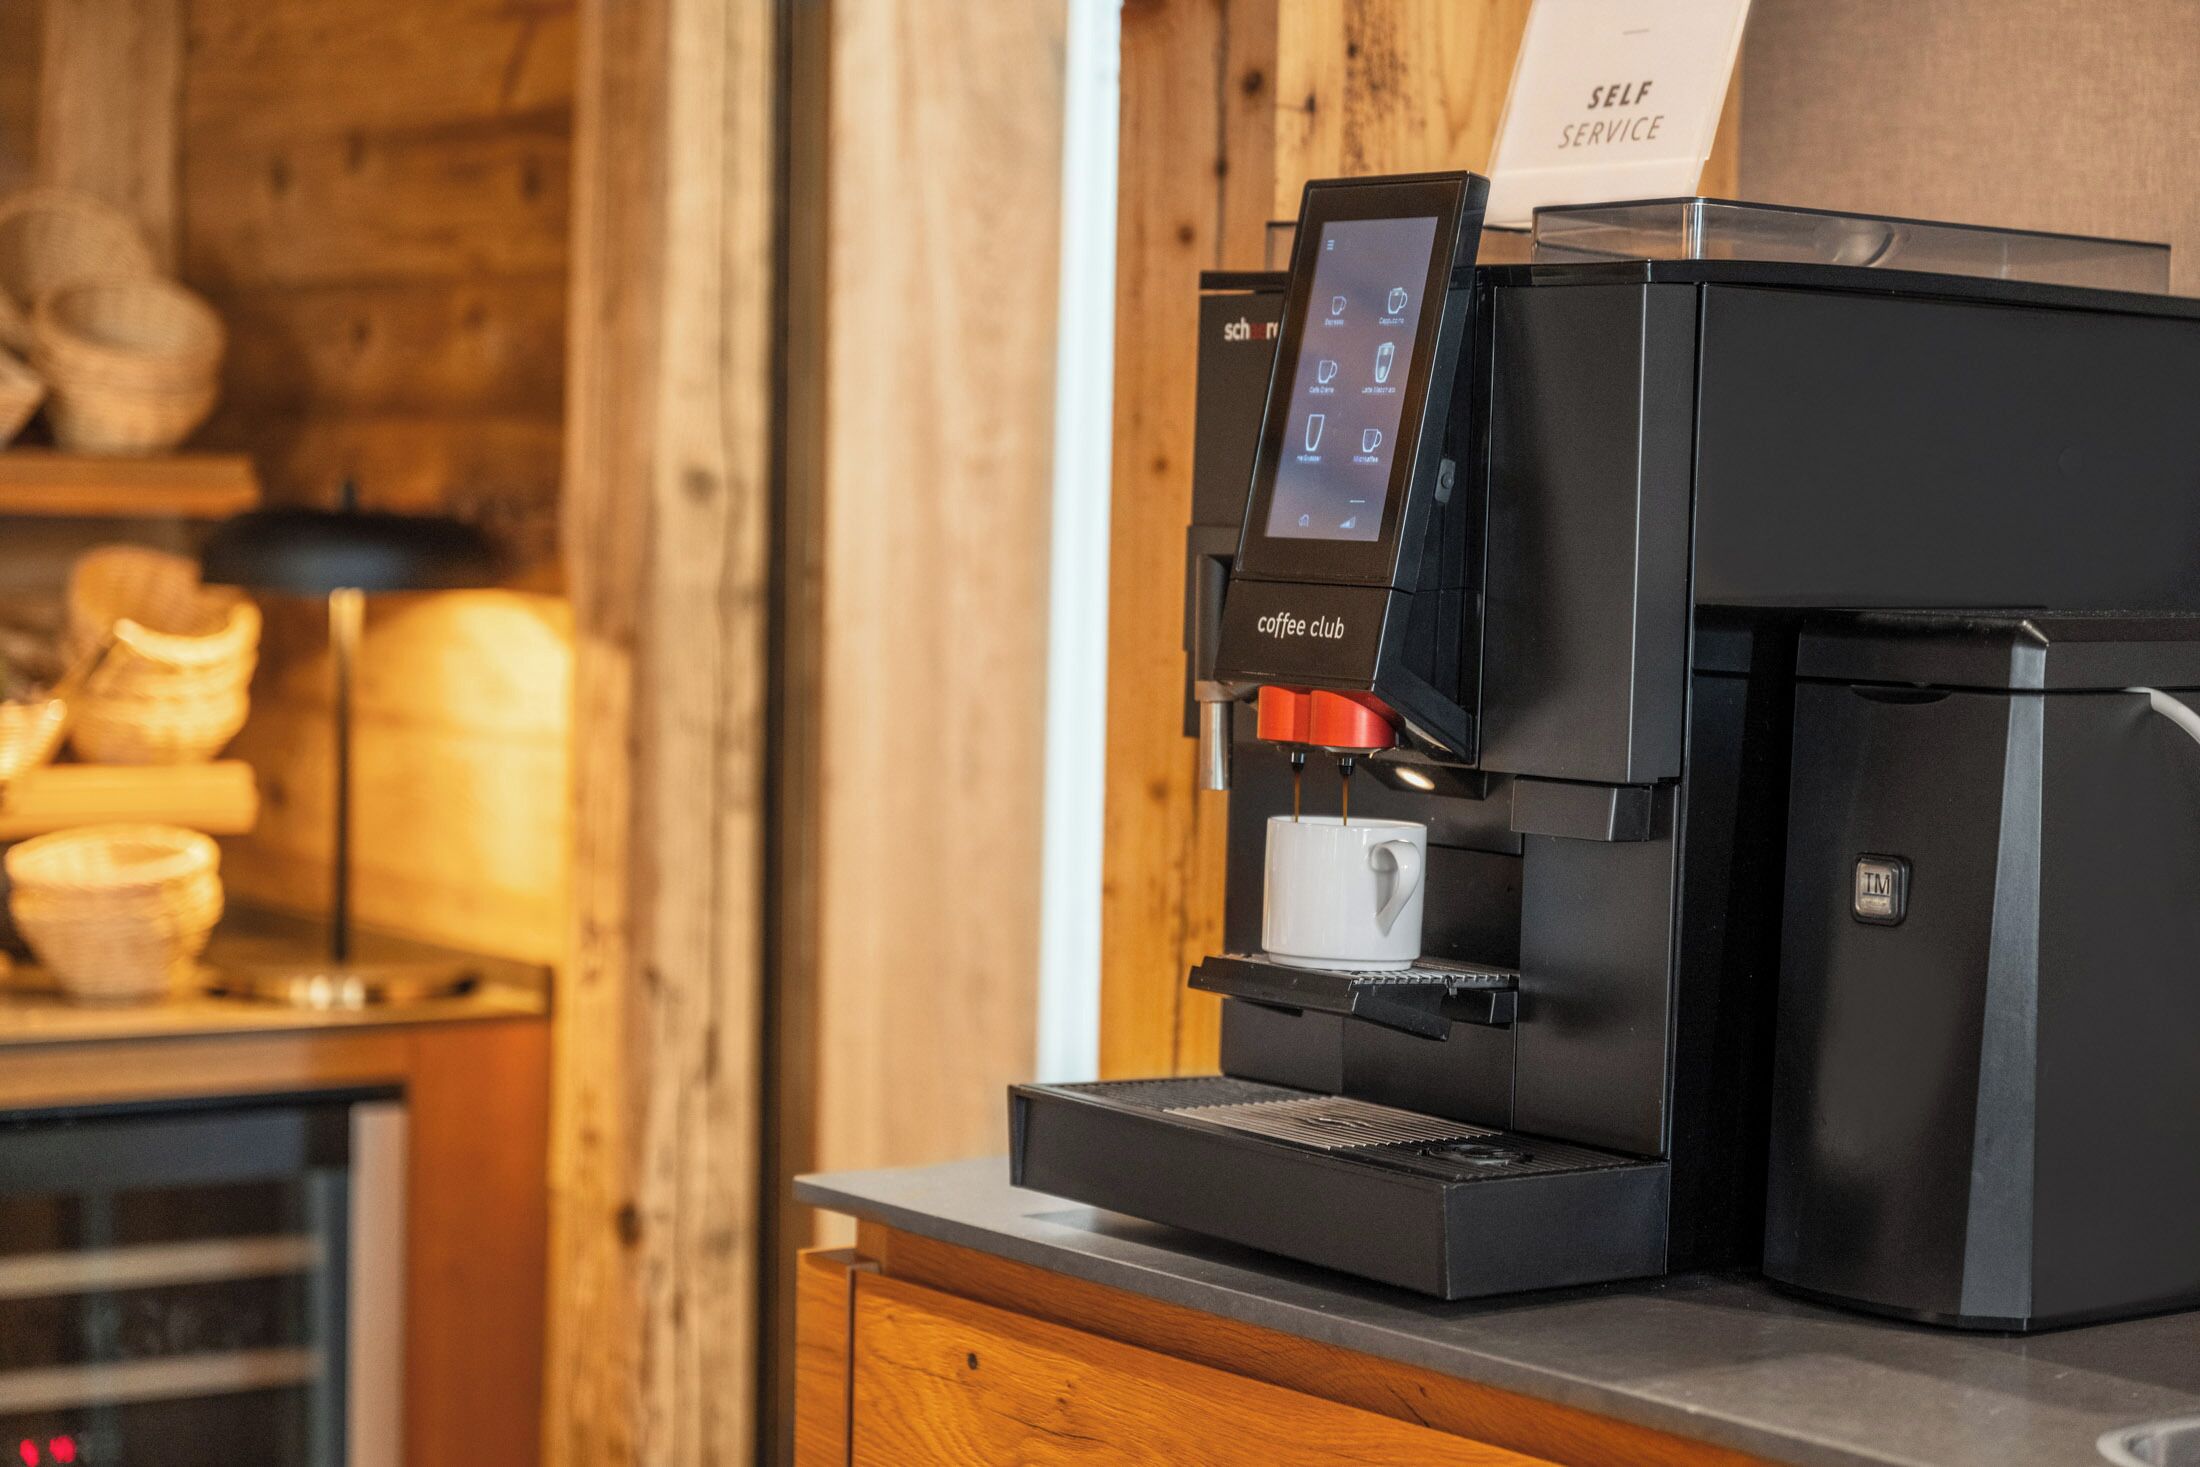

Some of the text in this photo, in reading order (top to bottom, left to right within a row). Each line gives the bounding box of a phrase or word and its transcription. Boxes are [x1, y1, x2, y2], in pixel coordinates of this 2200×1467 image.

[1587, 80, 1653, 110] SELF
[1557, 115, 1665, 149] SERVICE
[1257, 611, 1345, 639] coffee club
[1864, 871, 1890, 895] TM
